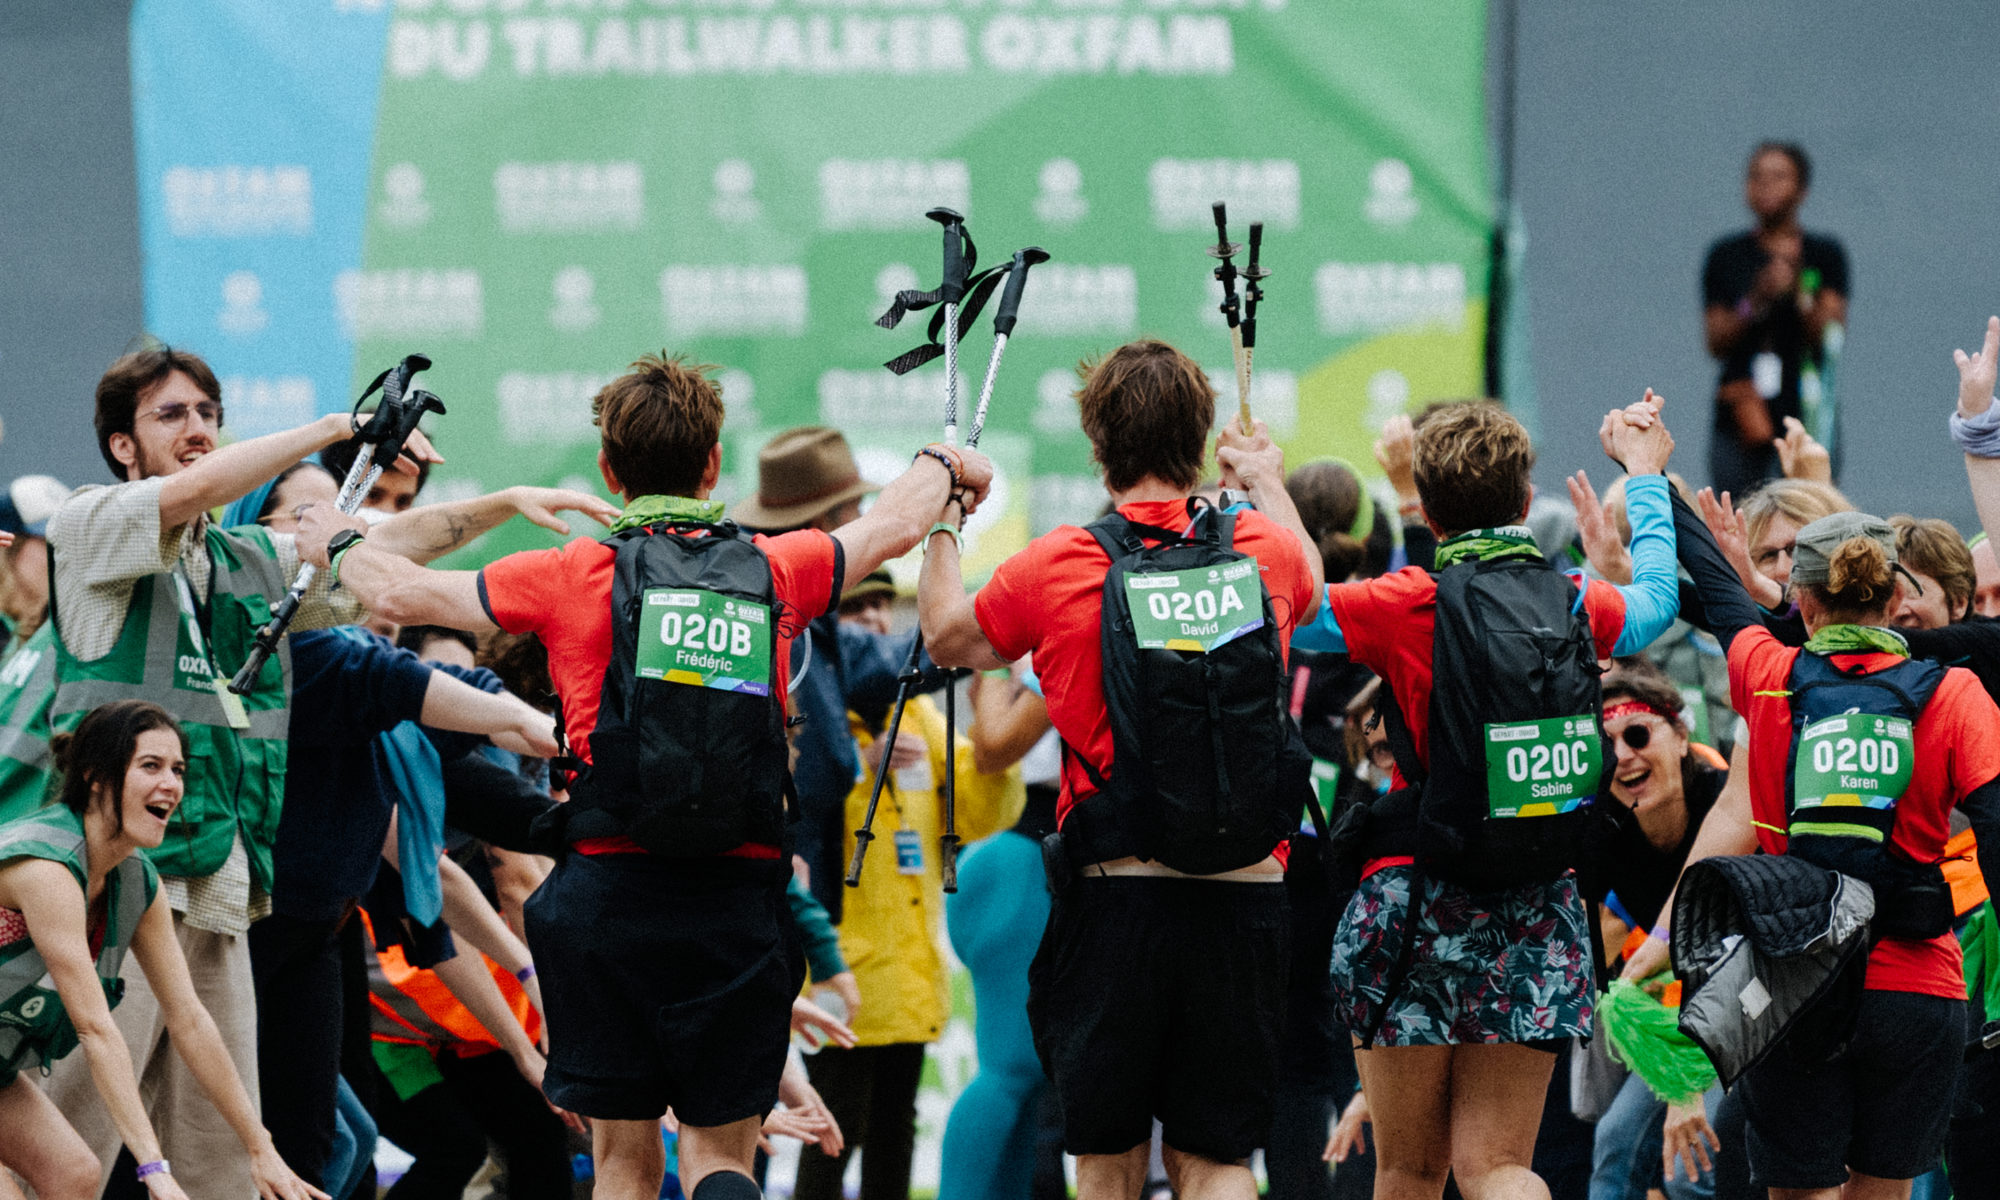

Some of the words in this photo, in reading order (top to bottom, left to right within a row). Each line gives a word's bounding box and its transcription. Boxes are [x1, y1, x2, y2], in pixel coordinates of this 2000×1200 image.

[386, 17, 491, 79] DU
[502, 14, 971, 75] TRAILWALKER
[980, 12, 1236, 74] OXFAM
[1148, 584, 1244, 621] 020A
[660, 611, 752, 657] 020B
[1181, 621, 1219, 636] David
[676, 649, 733, 672] Frédéric
[1507, 740, 1588, 782] 020C
[1813, 737, 1899, 775] 020D
[1531, 782, 1573, 797] Sabine
[1840, 775, 1879, 790] Karen
